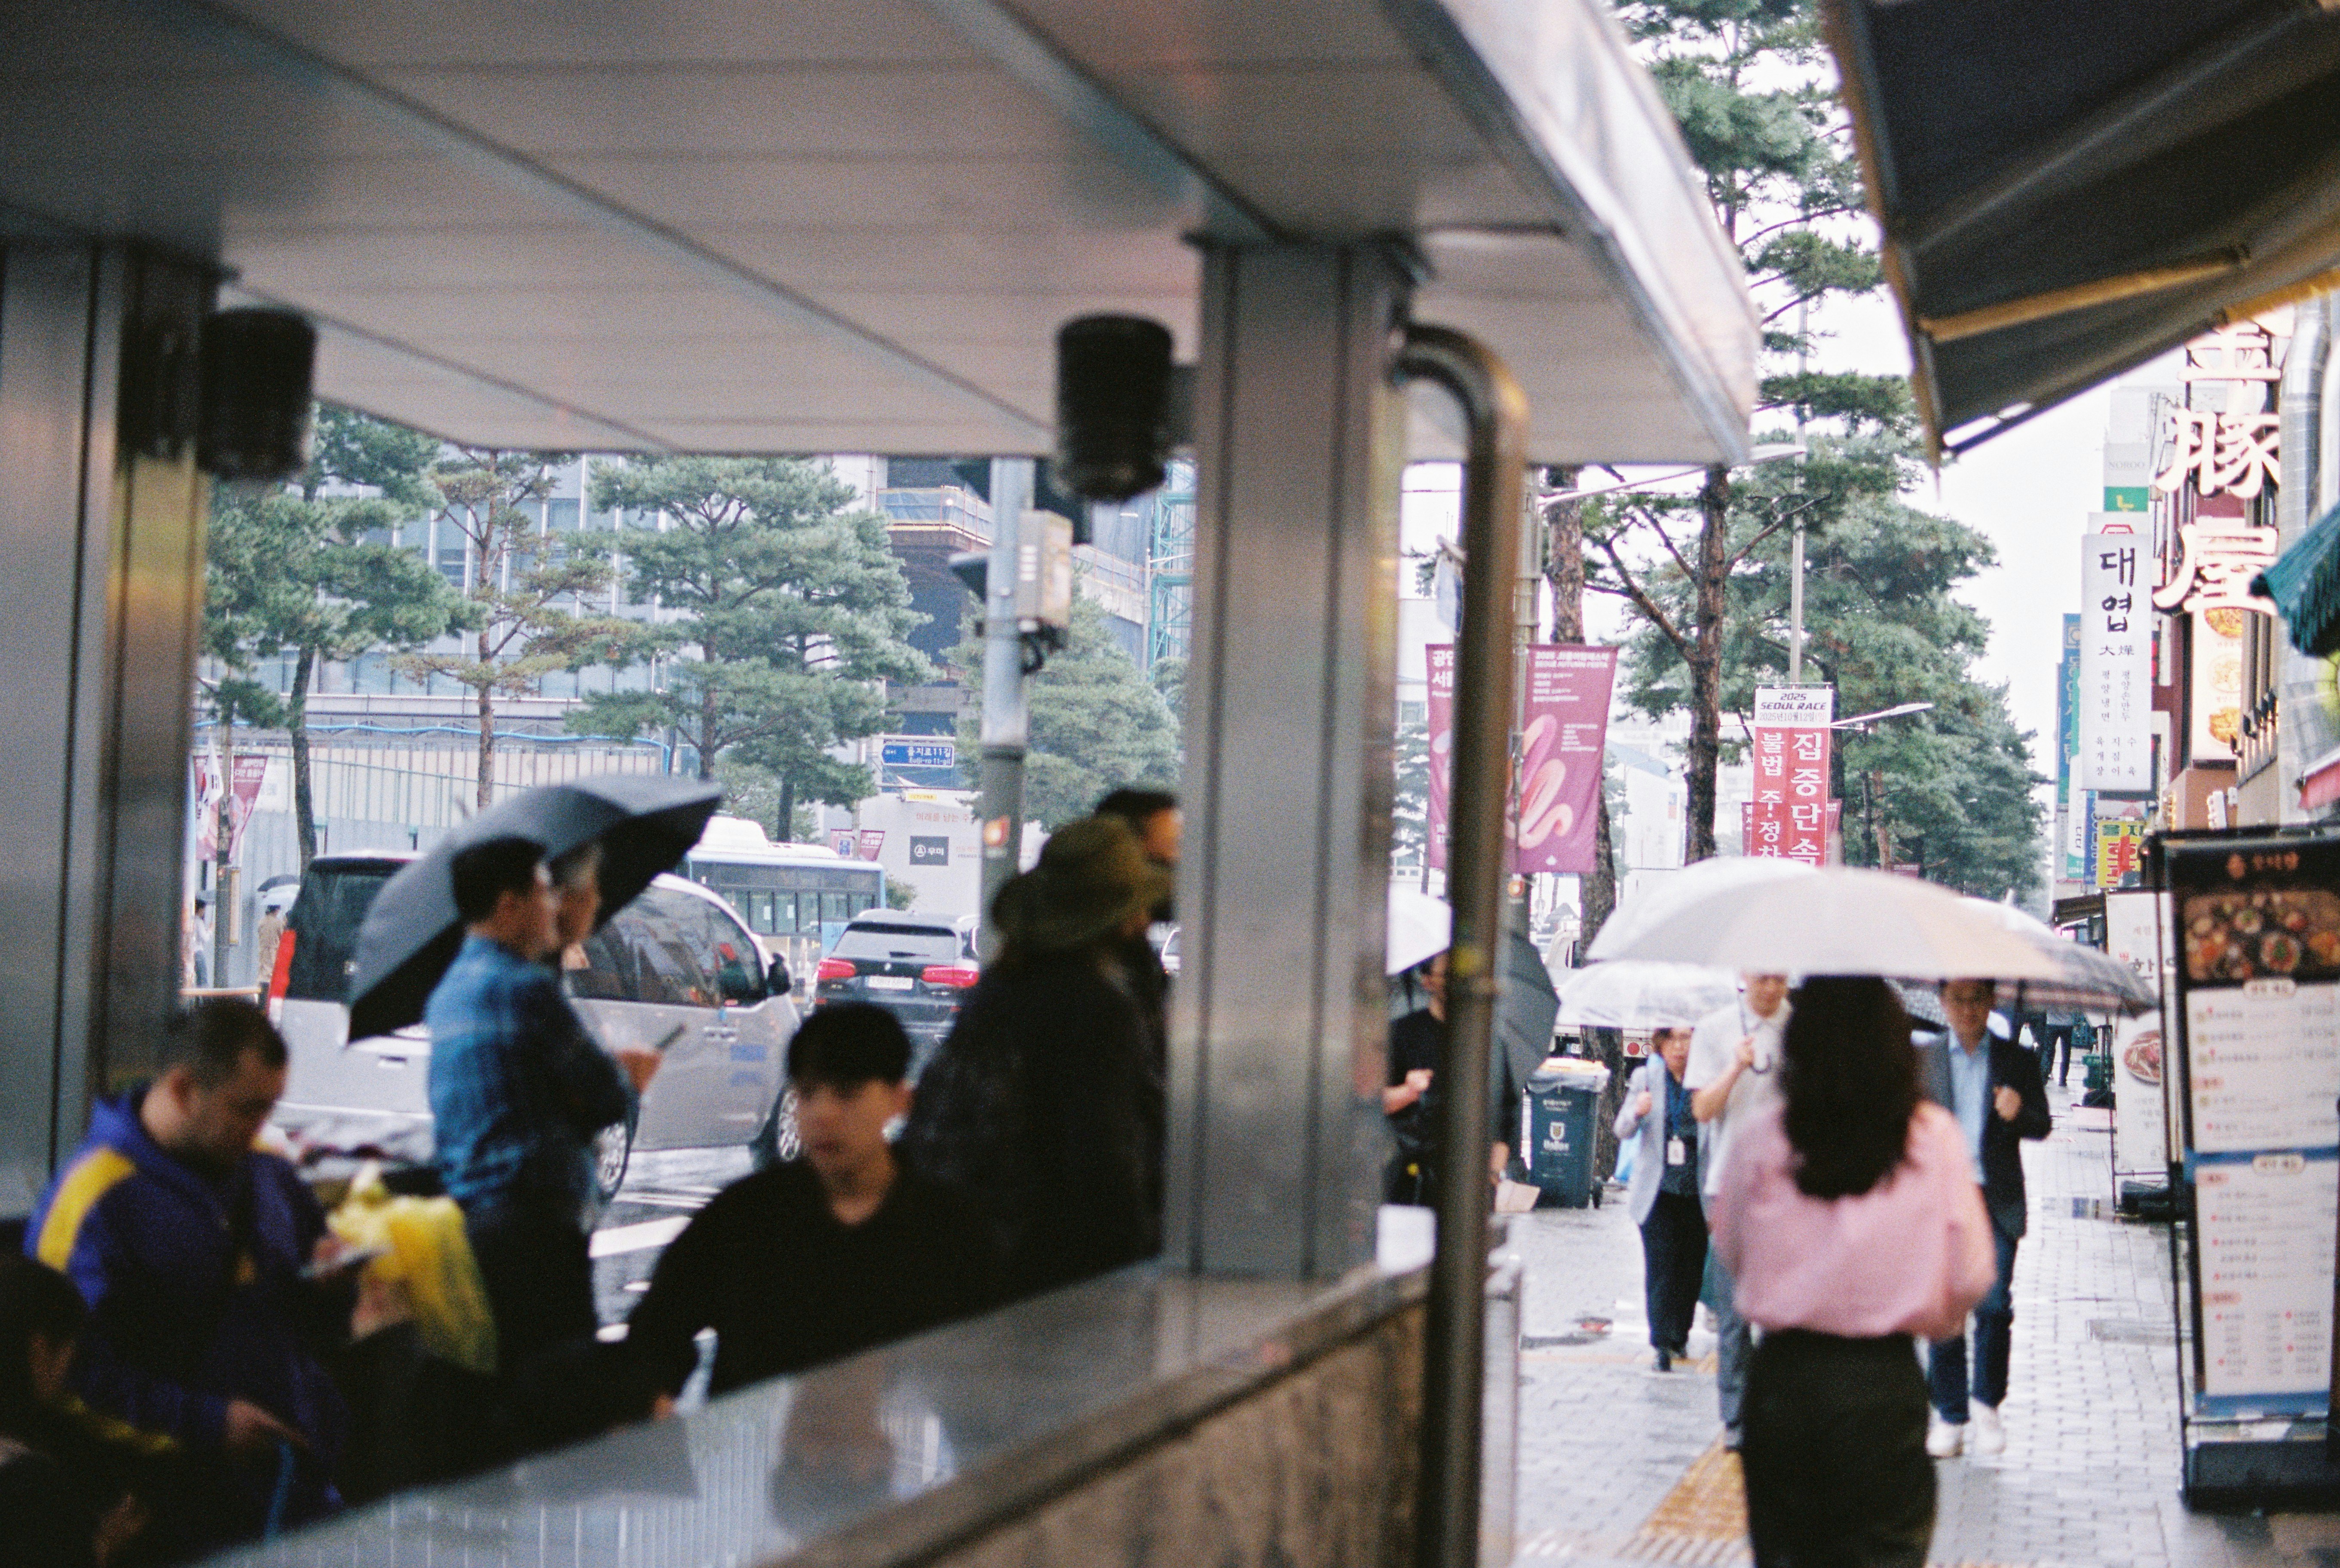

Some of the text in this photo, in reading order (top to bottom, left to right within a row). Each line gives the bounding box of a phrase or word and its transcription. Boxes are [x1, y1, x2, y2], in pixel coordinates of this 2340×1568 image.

[2099, 547, 2136, 633] 대엽
[1760, 702, 1827, 710] SEOUL RACE
[1760, 732, 1785, 776] 불법
[1788, 732, 1822, 865] 집중단속
[928, 847, 944, 856] 우미
